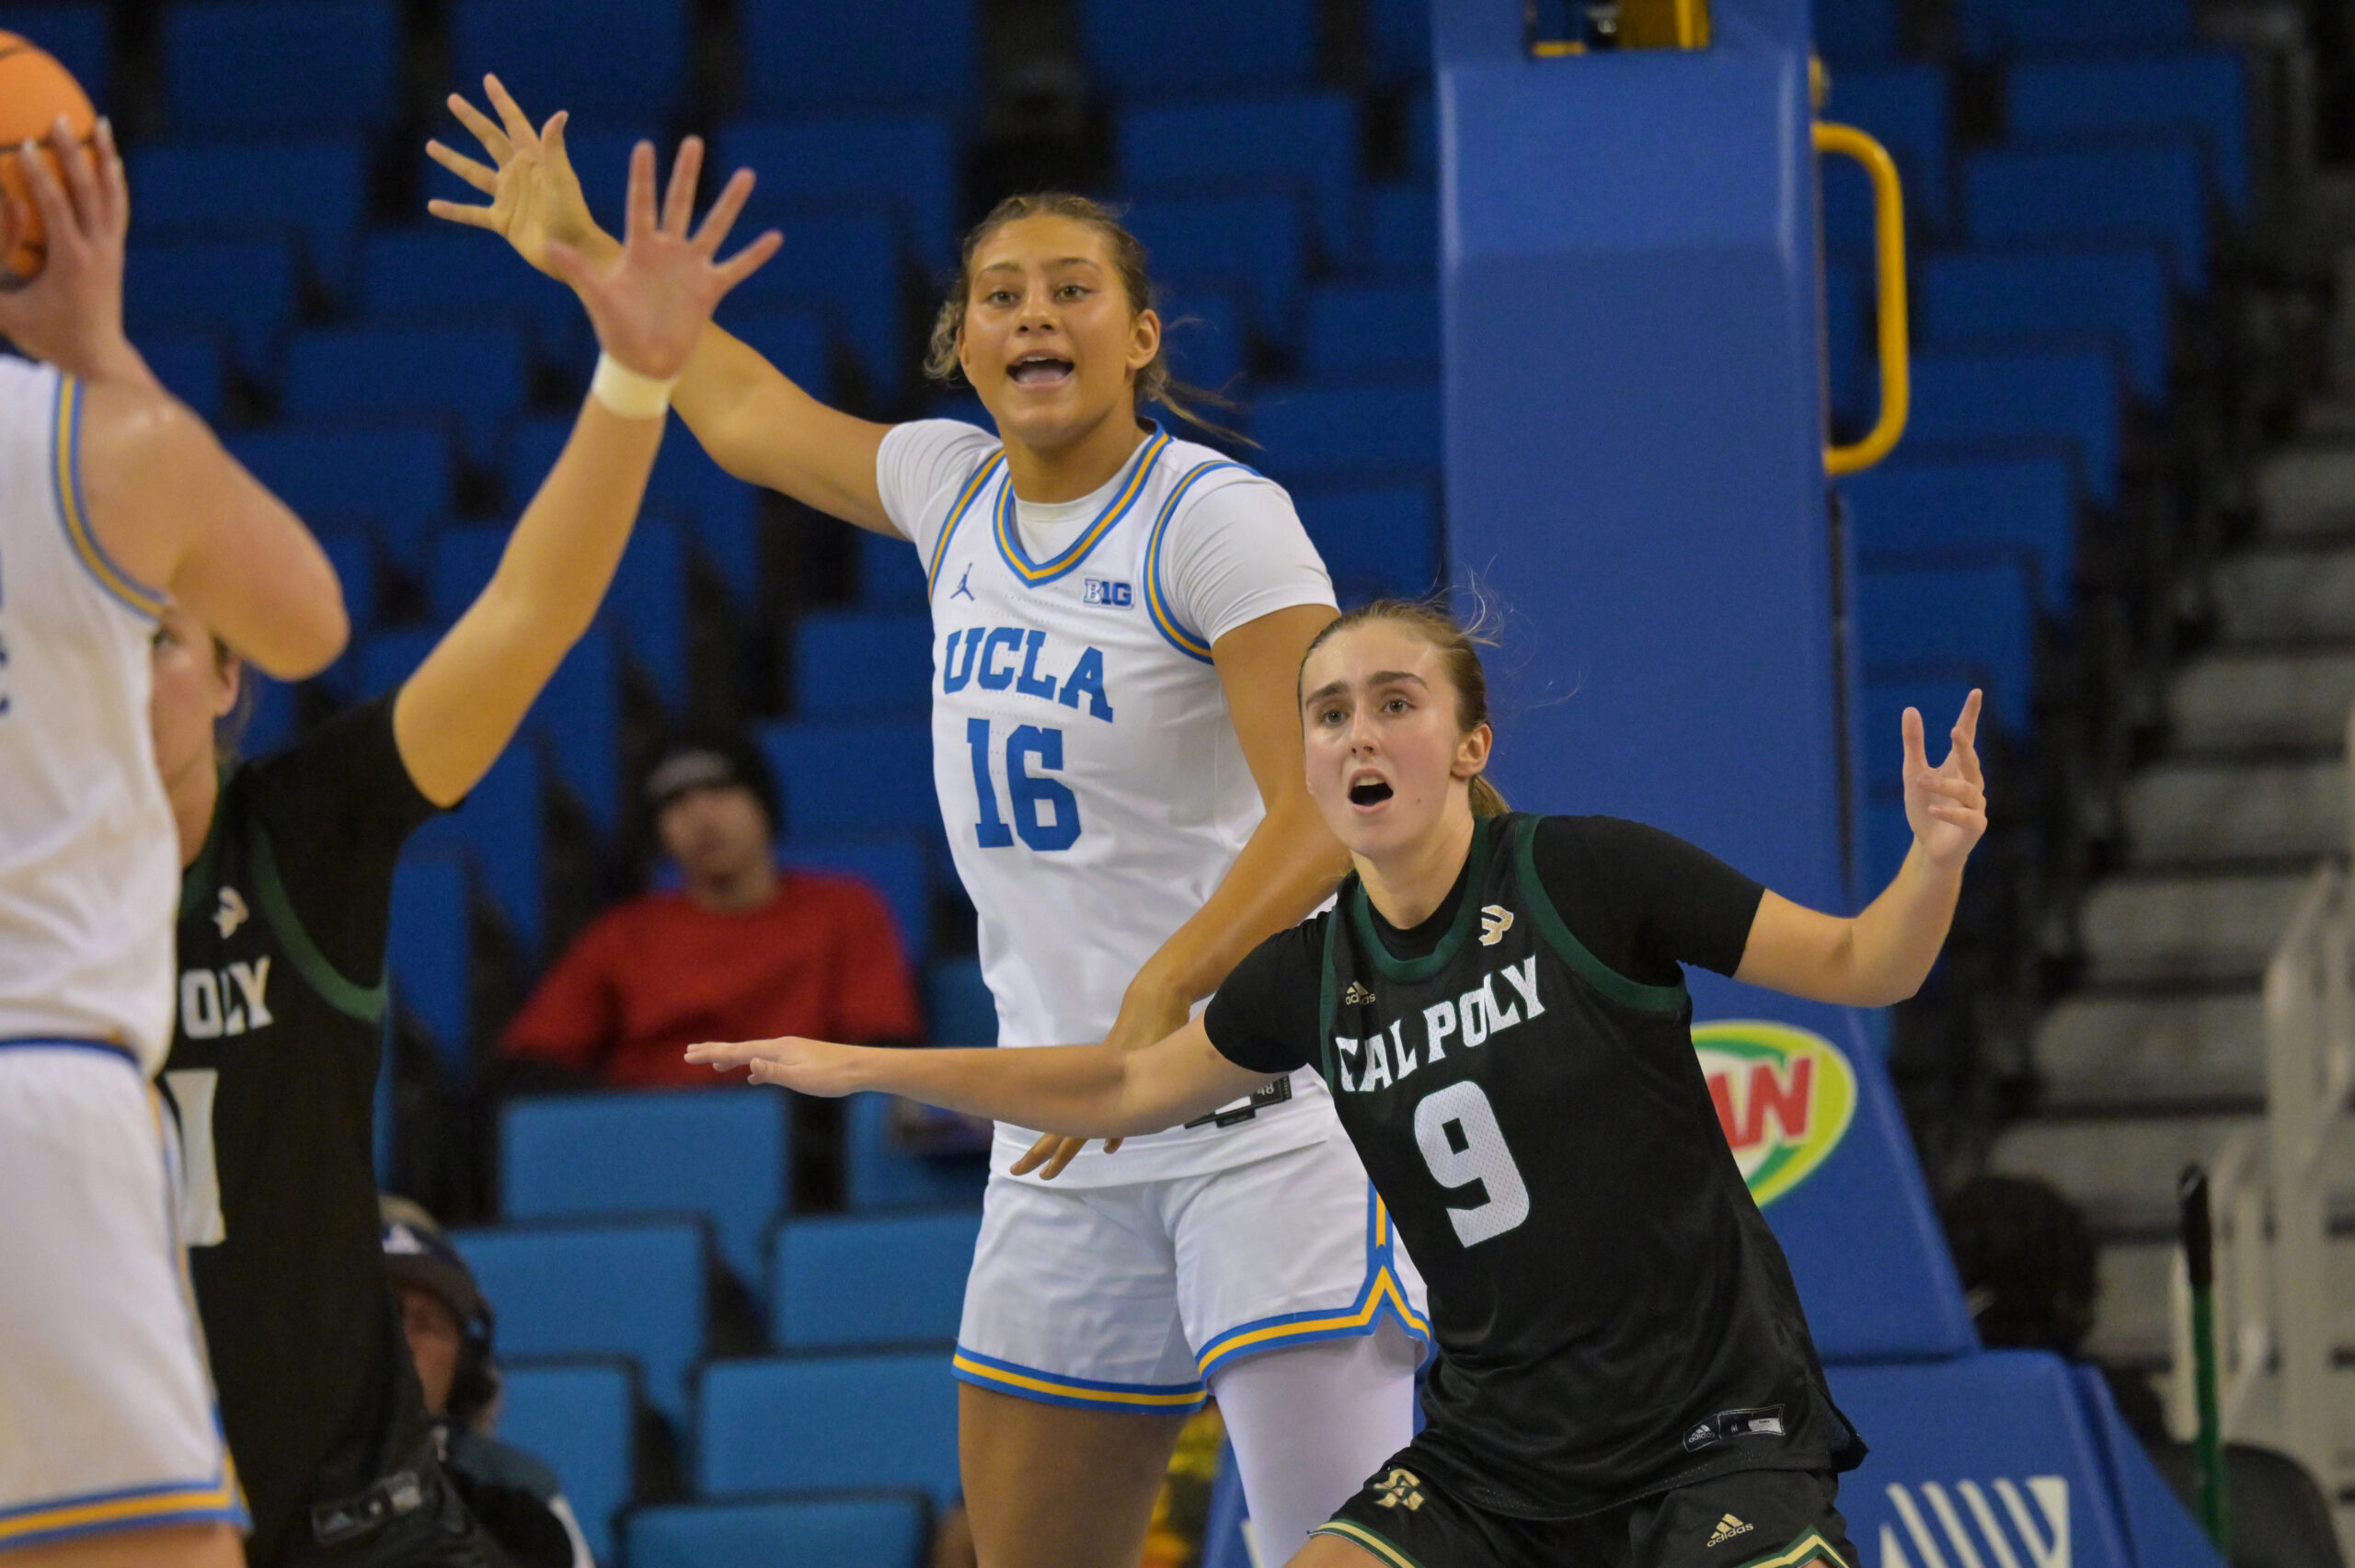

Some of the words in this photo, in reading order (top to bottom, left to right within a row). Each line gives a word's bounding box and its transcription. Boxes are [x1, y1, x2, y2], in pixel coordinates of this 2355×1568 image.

[944, 627, 1113, 723] UCLA
[967, 717, 1082, 851] 16
[1336, 1018, 1418, 1092] CAL
[1423, 954, 1545, 1064] POLY
[1346, 993, 1375, 1005] adas
[1414, 1081, 1530, 1248] 9
[1707, 1523, 1753, 1547] adidas
